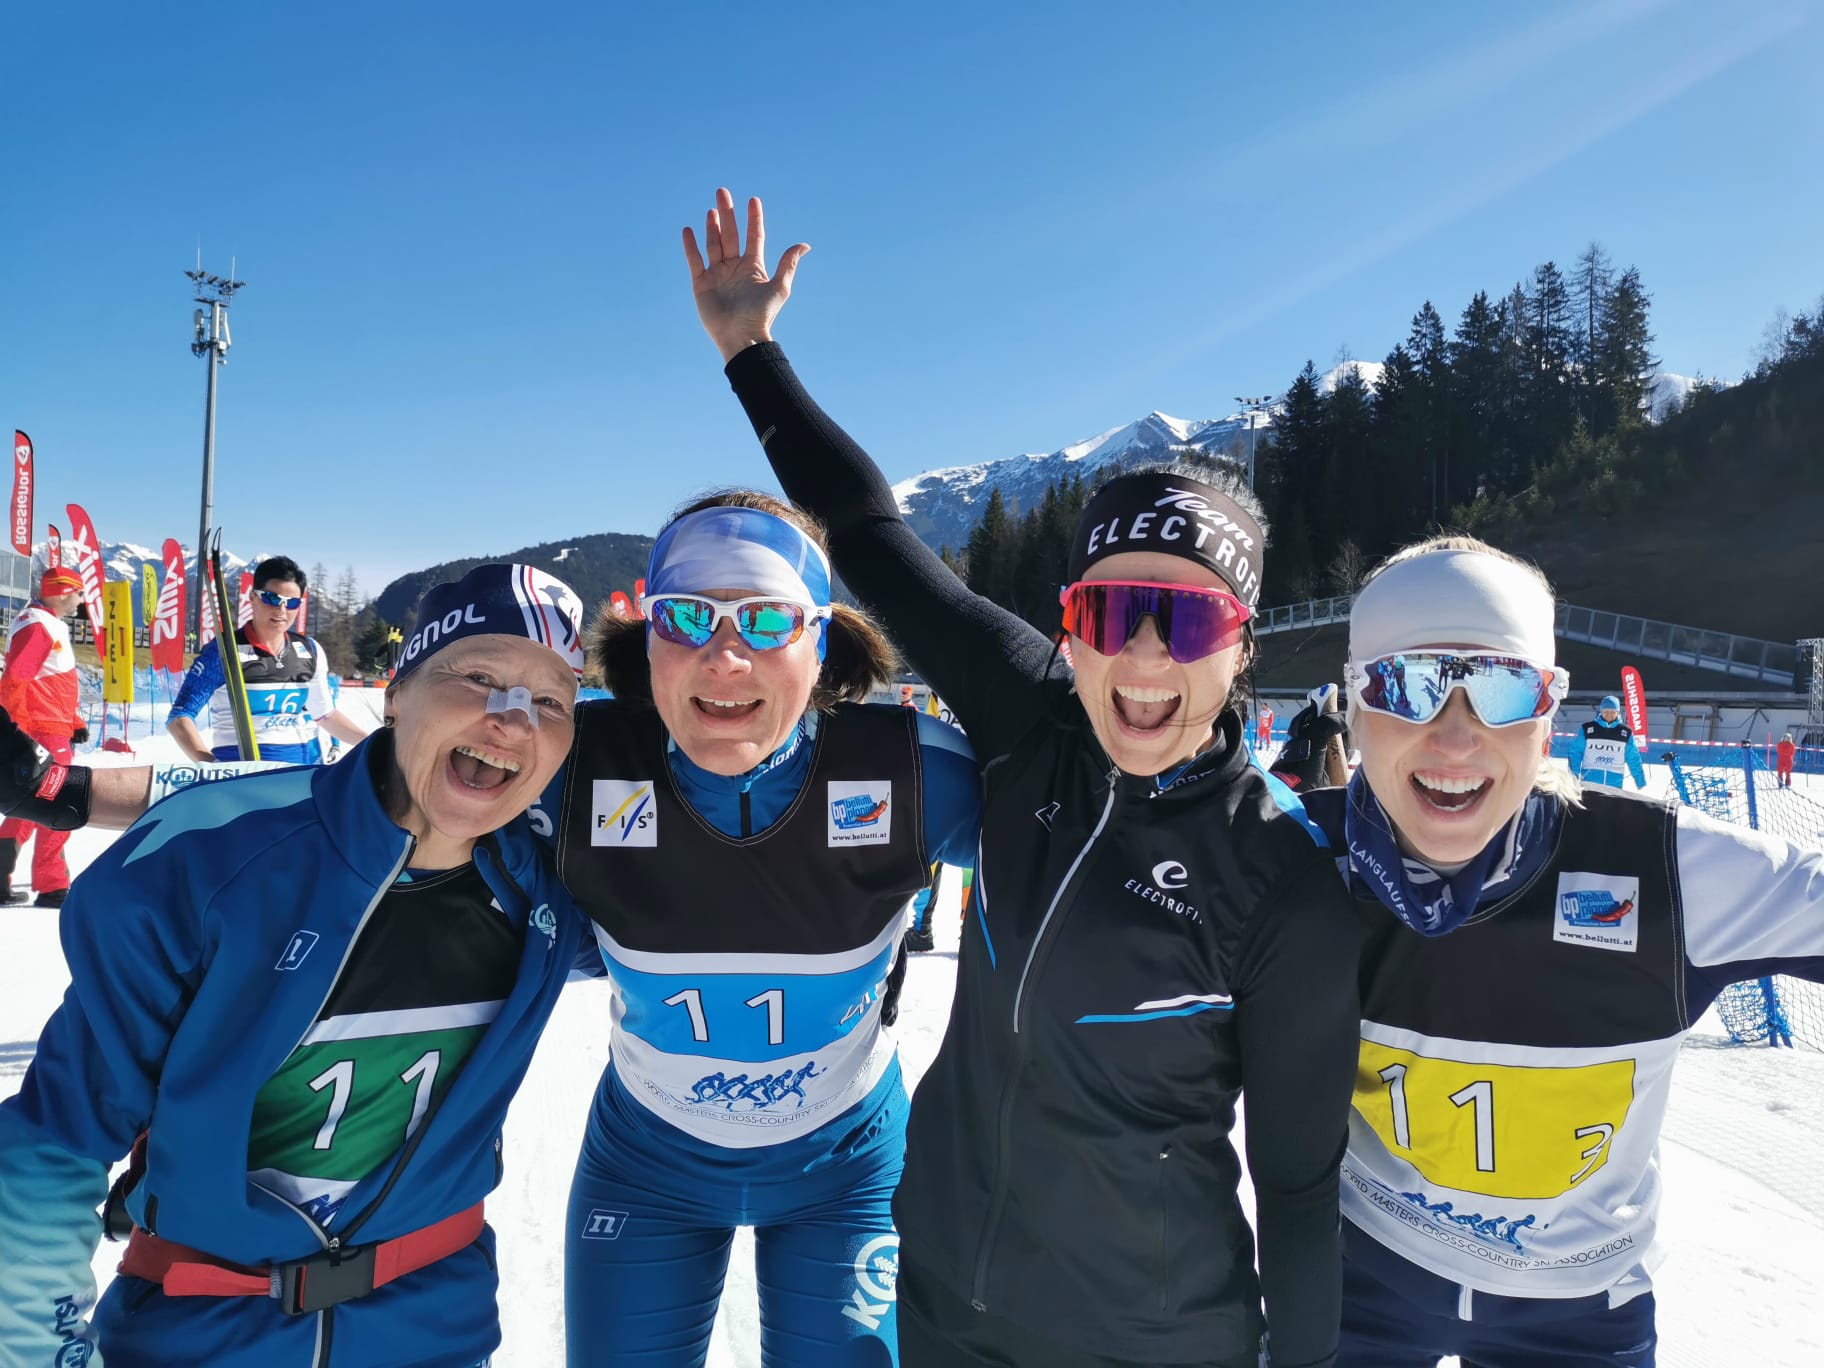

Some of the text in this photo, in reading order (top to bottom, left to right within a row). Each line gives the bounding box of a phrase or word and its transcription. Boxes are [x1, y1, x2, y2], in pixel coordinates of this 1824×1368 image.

[1155, 487, 1255, 551] Team
[109, 600, 117, 684] ZIEL
[264, 692, 301, 714] 16
[832, 832, 887, 841] www.bellutti.at
[1124, 879, 1202, 925] ELECTROFI
[1559, 931, 1633, 946] www.bellutti.at
[673, 1105, 718, 1118] MASTERS
[721, 1108, 812, 1125] CROSS-COUNTRY
[1570, 1122, 1614, 1184] 3
[1340, 1164, 1368, 1194] WORLD
[1370, 1192, 1420, 1227] MASTERS
[1422, 1223, 1531, 1269] CROSS-COUNTRY
